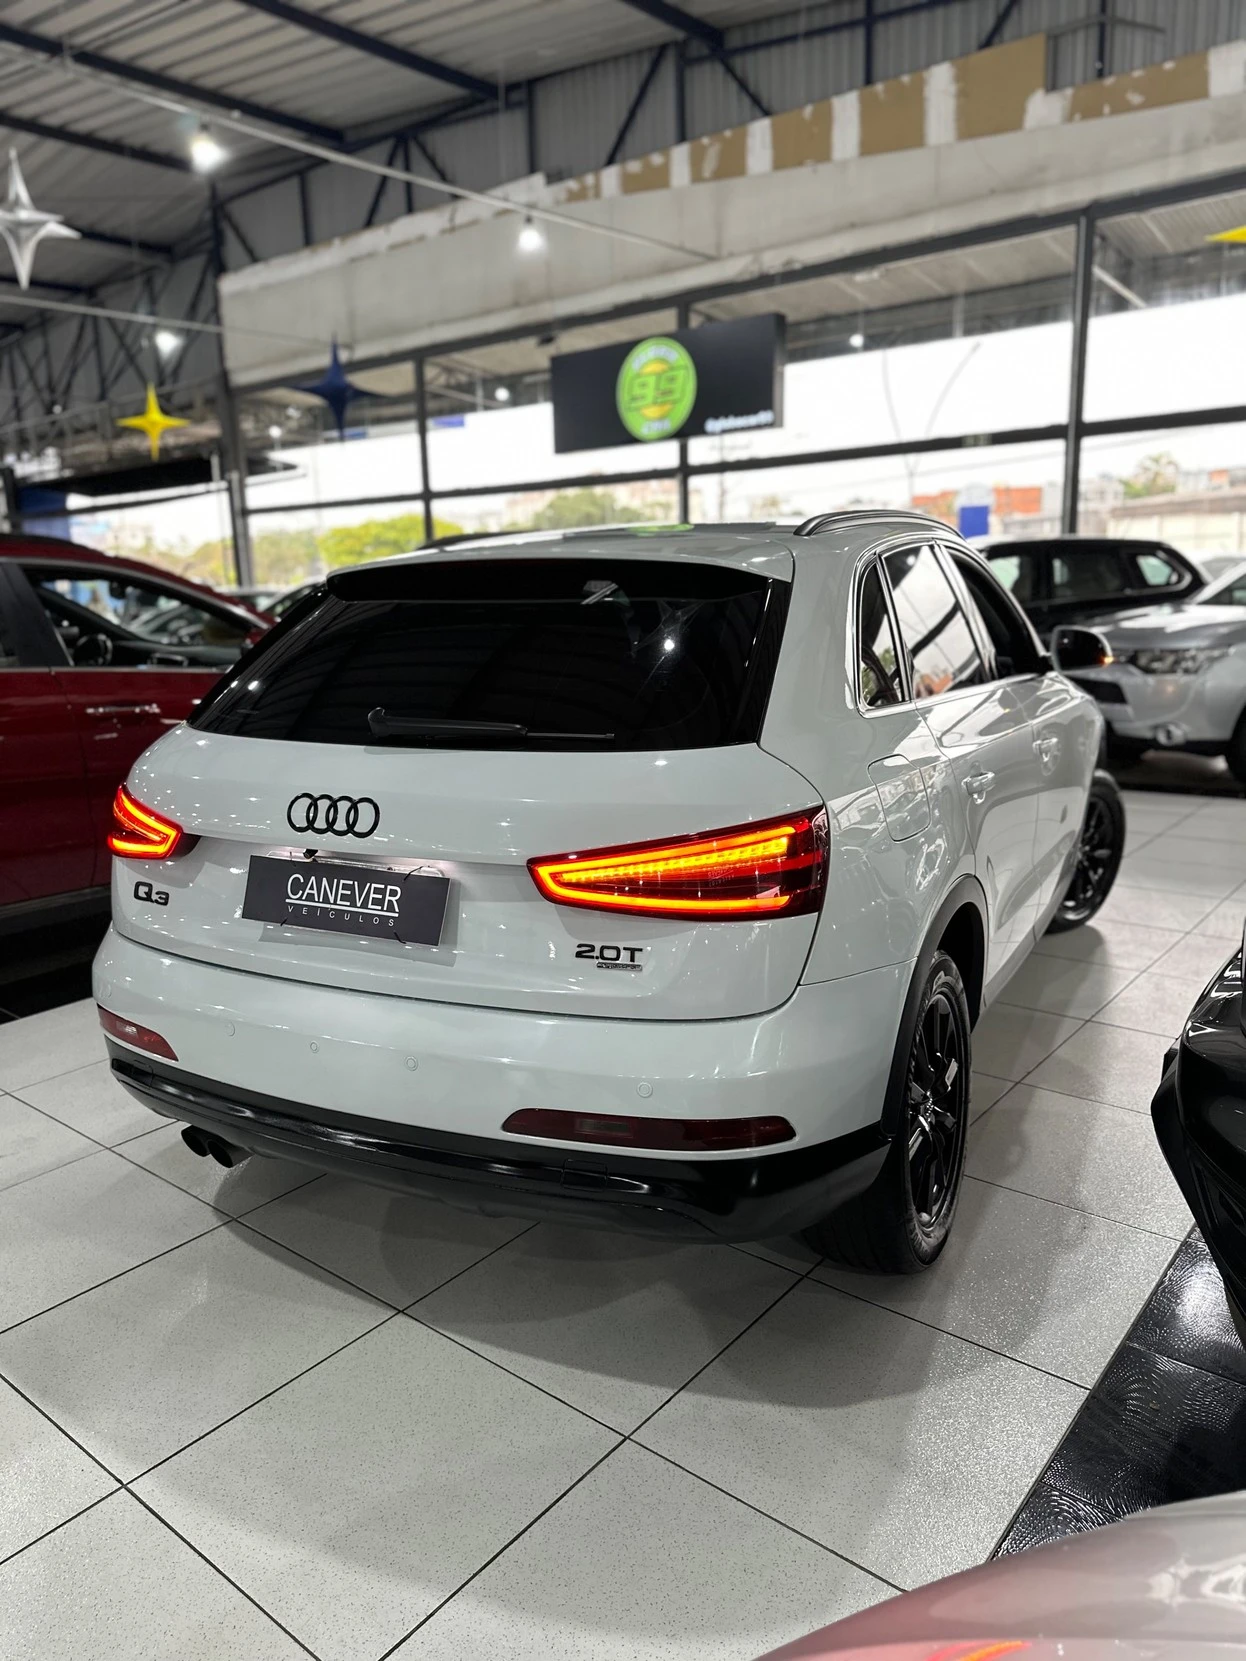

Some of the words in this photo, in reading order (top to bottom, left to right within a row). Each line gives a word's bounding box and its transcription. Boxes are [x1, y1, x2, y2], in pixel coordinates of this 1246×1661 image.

[133, 880, 170, 907] Q3
[287, 873, 401, 912] CANEVER
[575, 943, 643, 963] 2.0T
